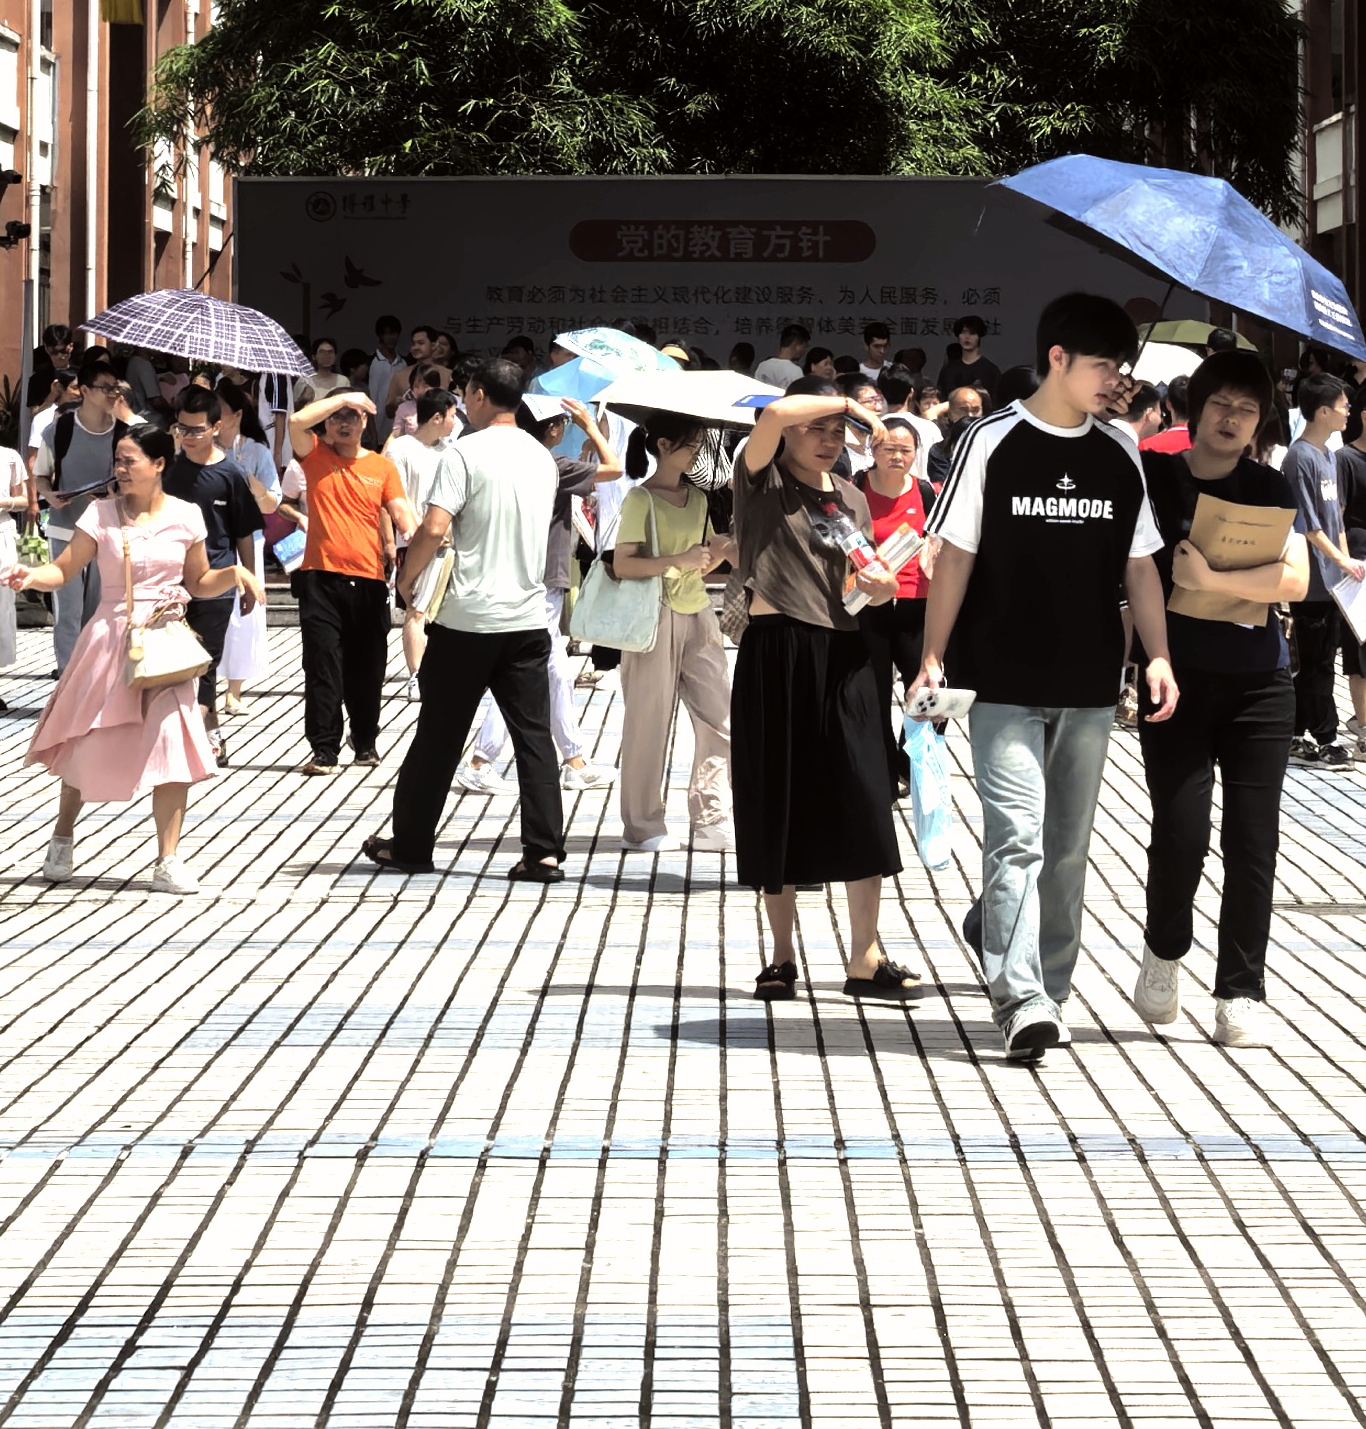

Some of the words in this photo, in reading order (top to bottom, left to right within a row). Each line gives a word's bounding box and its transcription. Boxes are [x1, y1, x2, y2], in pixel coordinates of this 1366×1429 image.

[617, 224, 831, 259] 党的教育方针
[1011, 496, 1114, 520] MAGMODE
